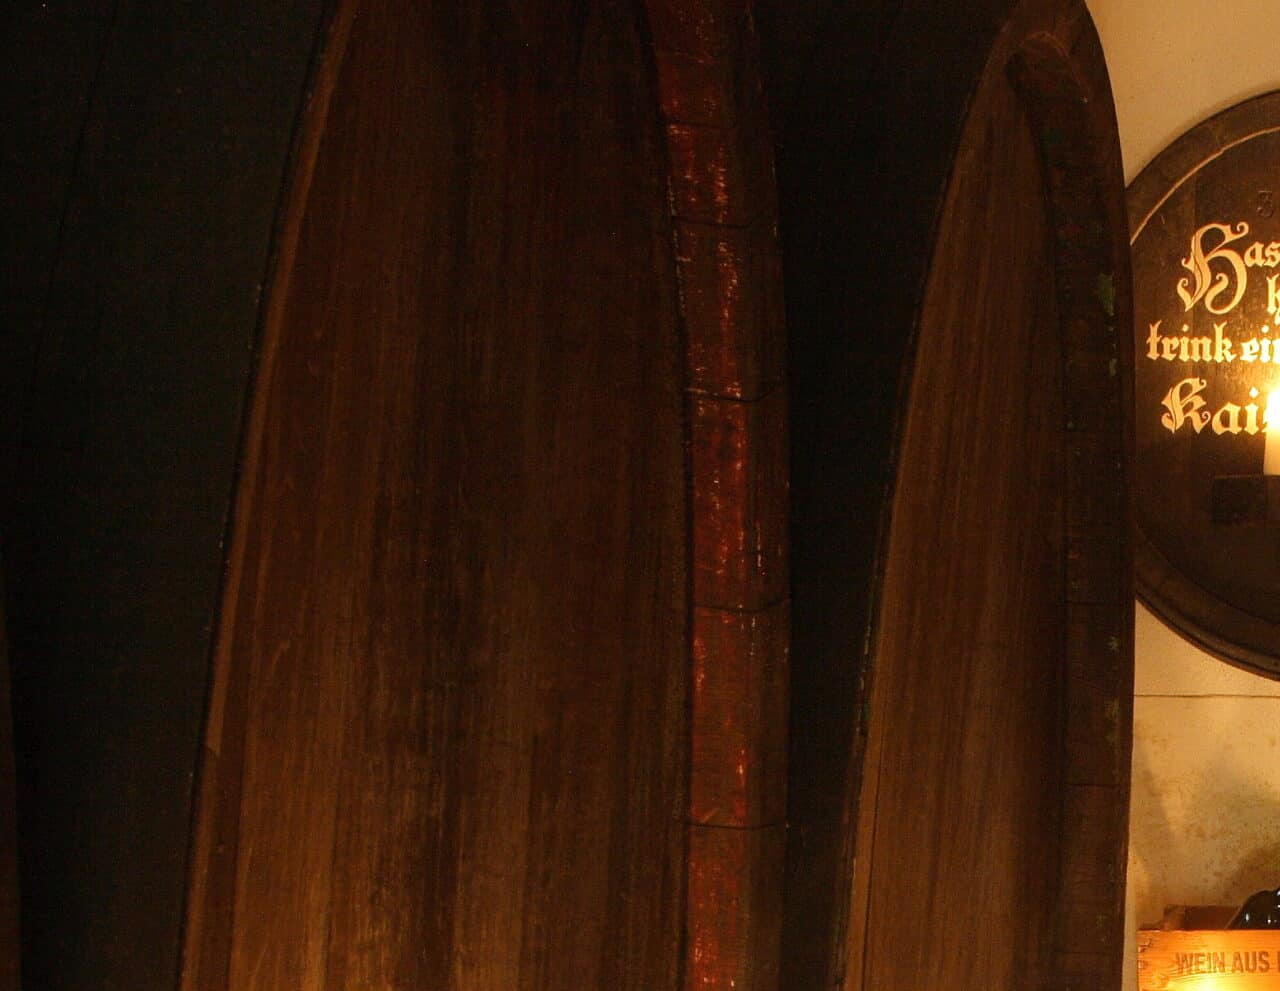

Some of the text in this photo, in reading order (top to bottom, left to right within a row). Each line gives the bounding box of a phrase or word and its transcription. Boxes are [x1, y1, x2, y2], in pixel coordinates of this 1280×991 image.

[1146, 321, 1237, 363] trink
[1175, 951, 1226, 974] WEIN
[1231, 951, 1270, 973] AUS
